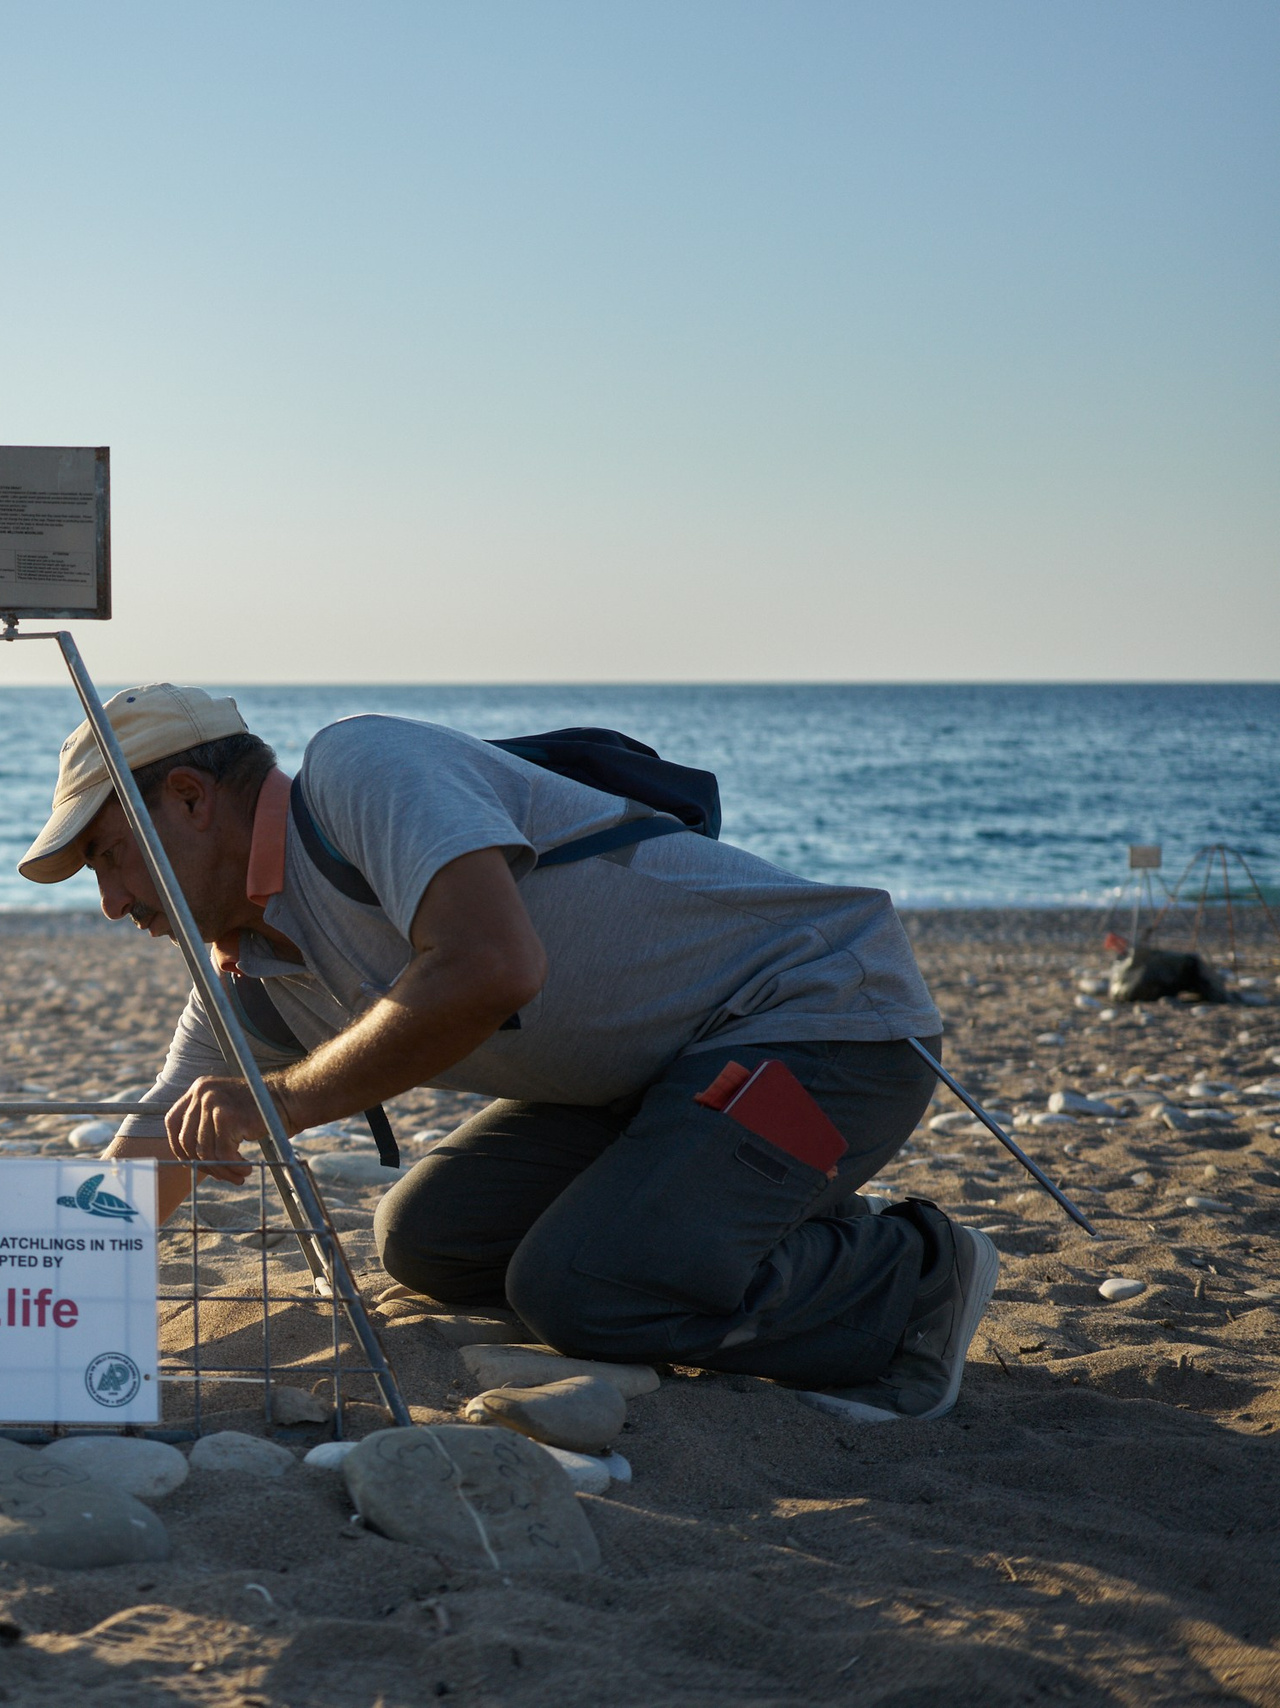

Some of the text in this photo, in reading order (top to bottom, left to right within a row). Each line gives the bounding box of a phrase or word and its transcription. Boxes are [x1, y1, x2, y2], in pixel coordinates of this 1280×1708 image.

[91, 1239, 105, 1250] IN
[109, 1239, 144, 1251] THIS
[42, 1256, 64, 1268] BY
